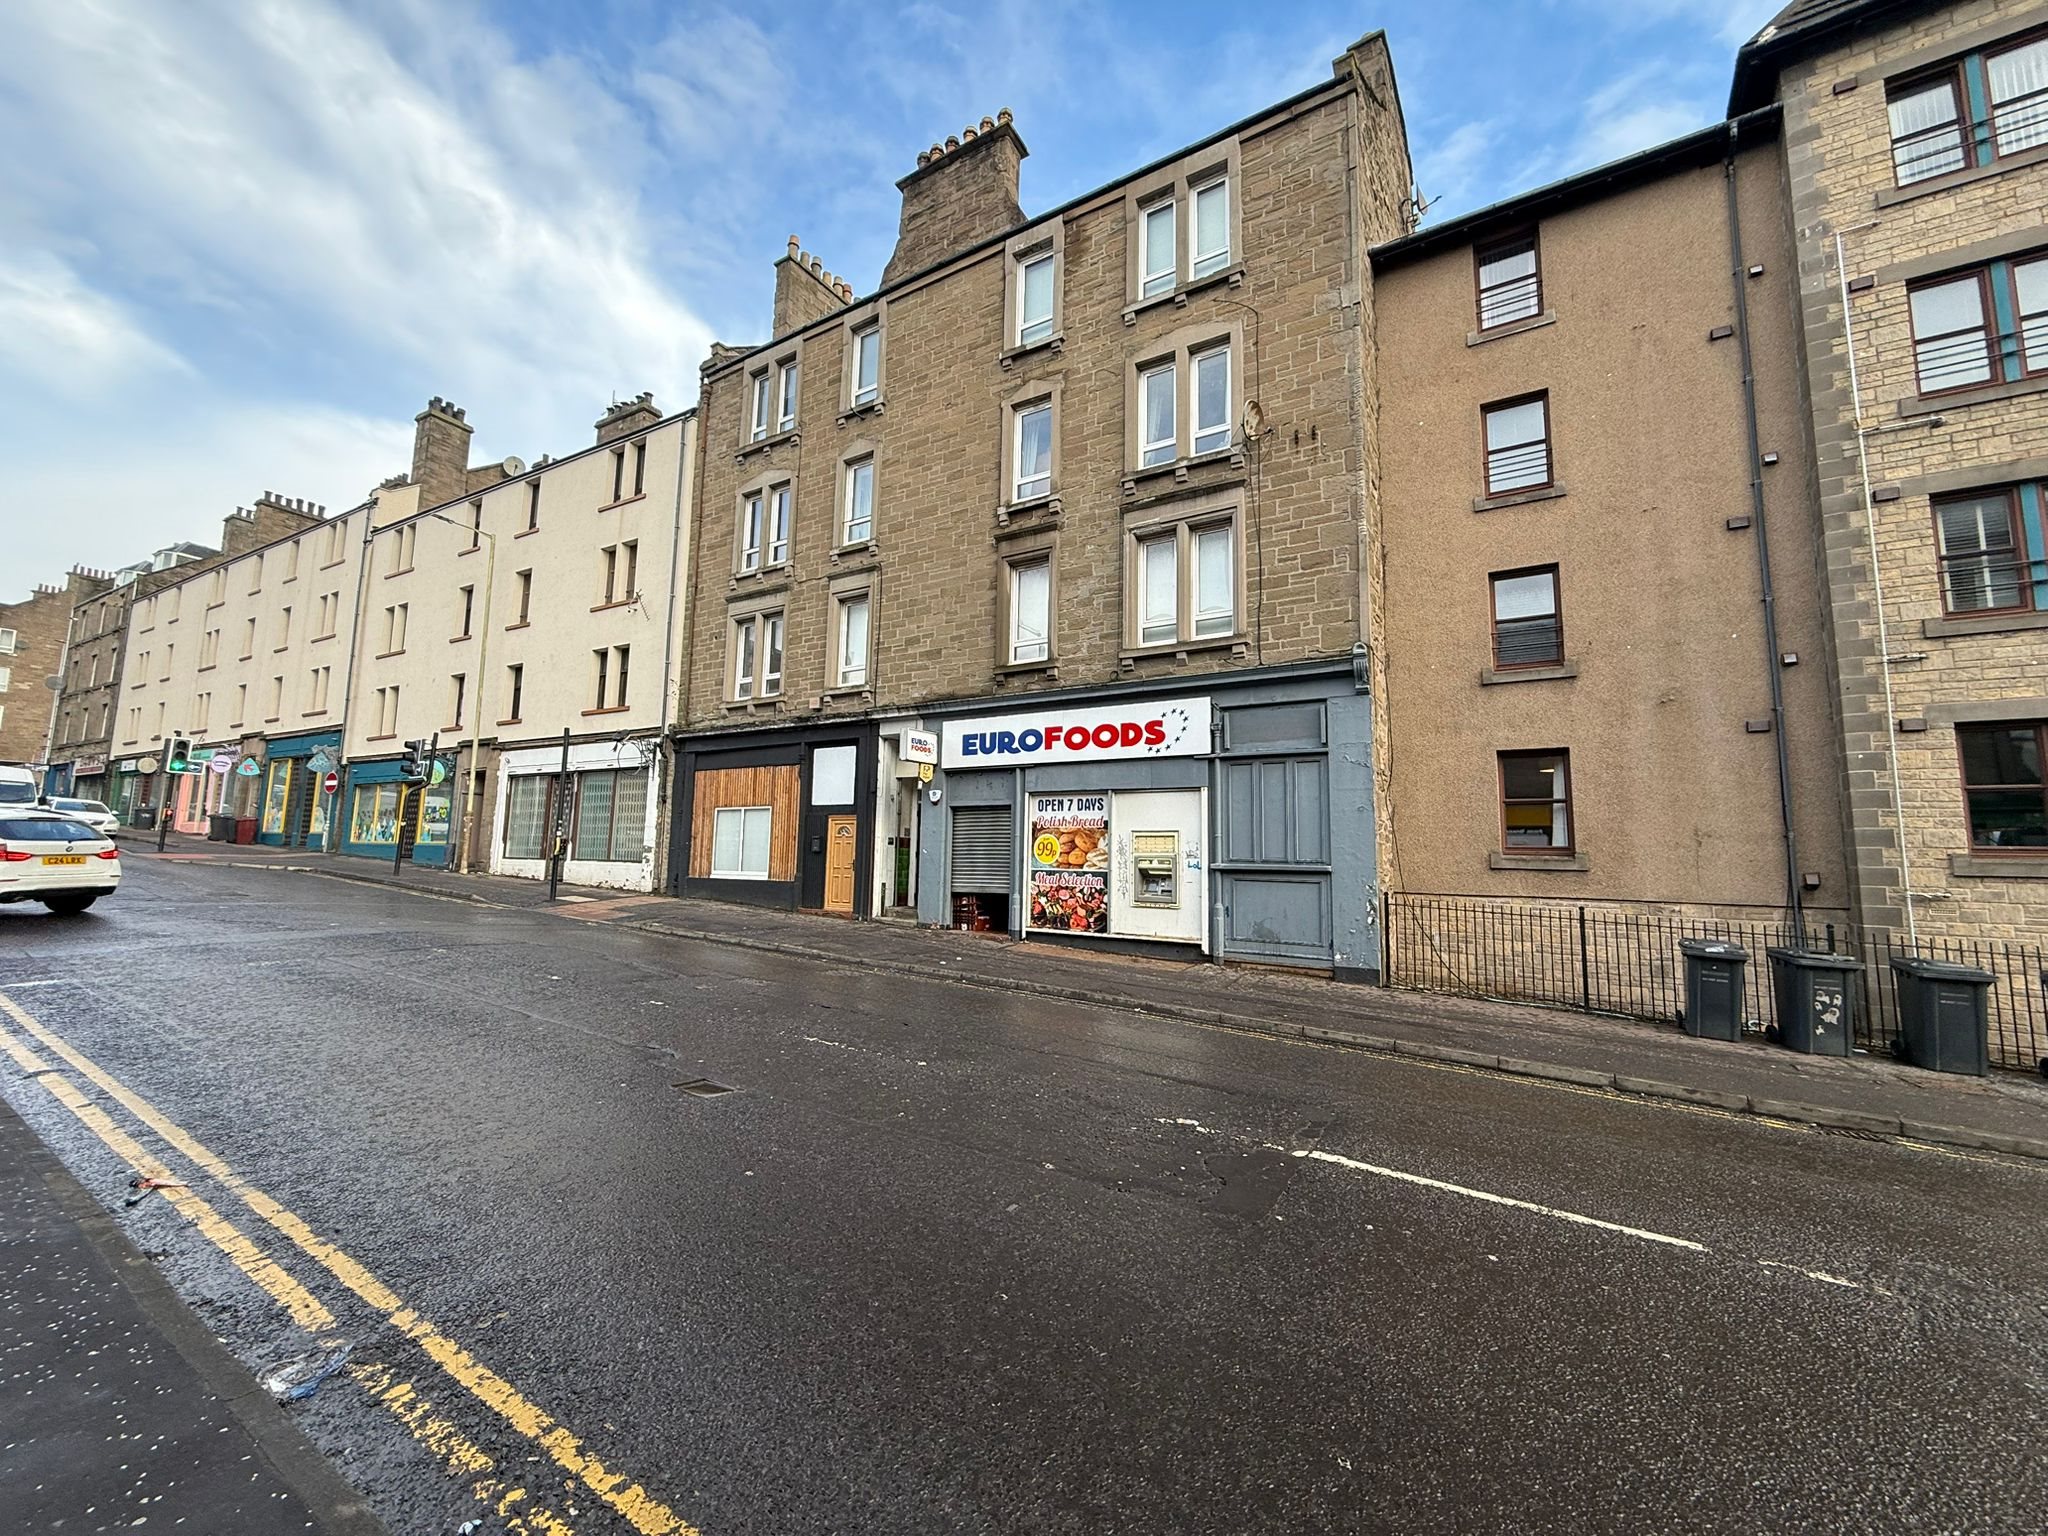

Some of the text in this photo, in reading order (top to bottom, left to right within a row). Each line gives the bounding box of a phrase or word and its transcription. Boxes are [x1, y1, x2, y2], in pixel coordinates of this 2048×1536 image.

[911, 737, 928, 746] EURO
[962, 720, 1166, 756] EUROFOODS
[911, 745, 931, 753] FOODS
[1038, 798, 1104, 812] OPEN 7 DAYS
[1037, 815, 1104, 828] Polish Bread
[48, 857, 64, 865] C24
[1035, 872, 1104, 889] Meat Selection
